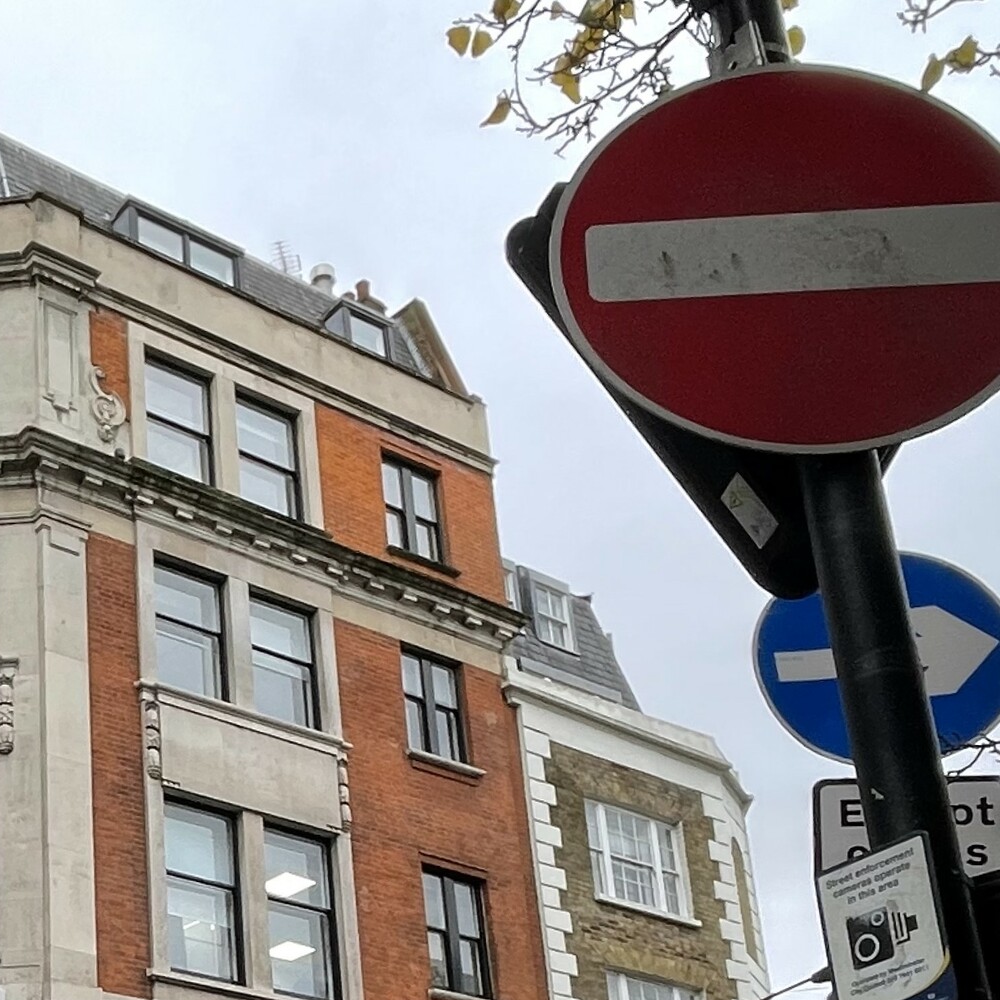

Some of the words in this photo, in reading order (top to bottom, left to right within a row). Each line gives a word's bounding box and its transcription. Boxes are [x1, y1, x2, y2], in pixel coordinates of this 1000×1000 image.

[825, 872, 853, 890] Street
[855, 847, 914, 878] enforcement
[833, 877, 872, 899] cameras
[874, 862, 911, 883] operate
[847, 896, 857, 905] in
[858, 887, 876, 900] this
[879, 878, 899, 893] area
